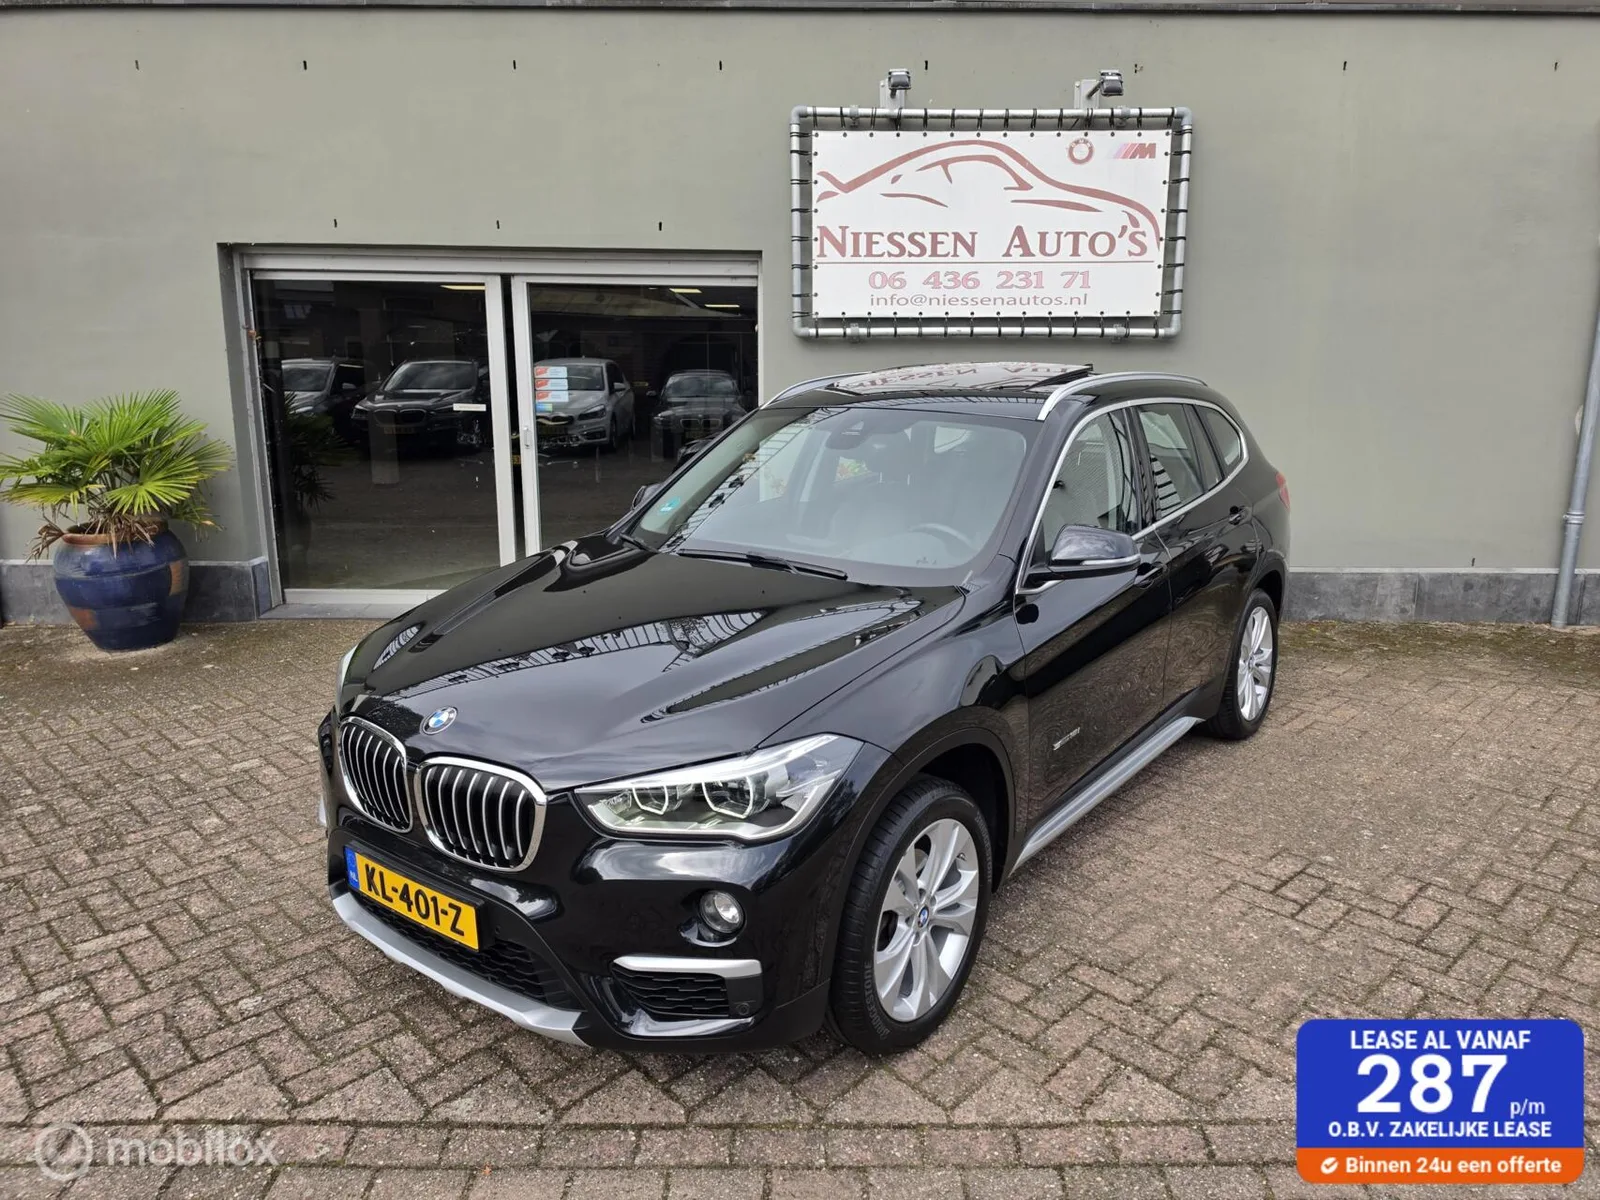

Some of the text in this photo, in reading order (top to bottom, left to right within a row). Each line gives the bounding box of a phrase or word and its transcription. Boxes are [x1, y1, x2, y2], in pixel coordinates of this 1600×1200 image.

[868, 270, 1091, 290] 06 436 231 71
[870, 294, 1088, 307] info@niessenautos.nl
[364, 863, 465, 937] KL-401-Z
